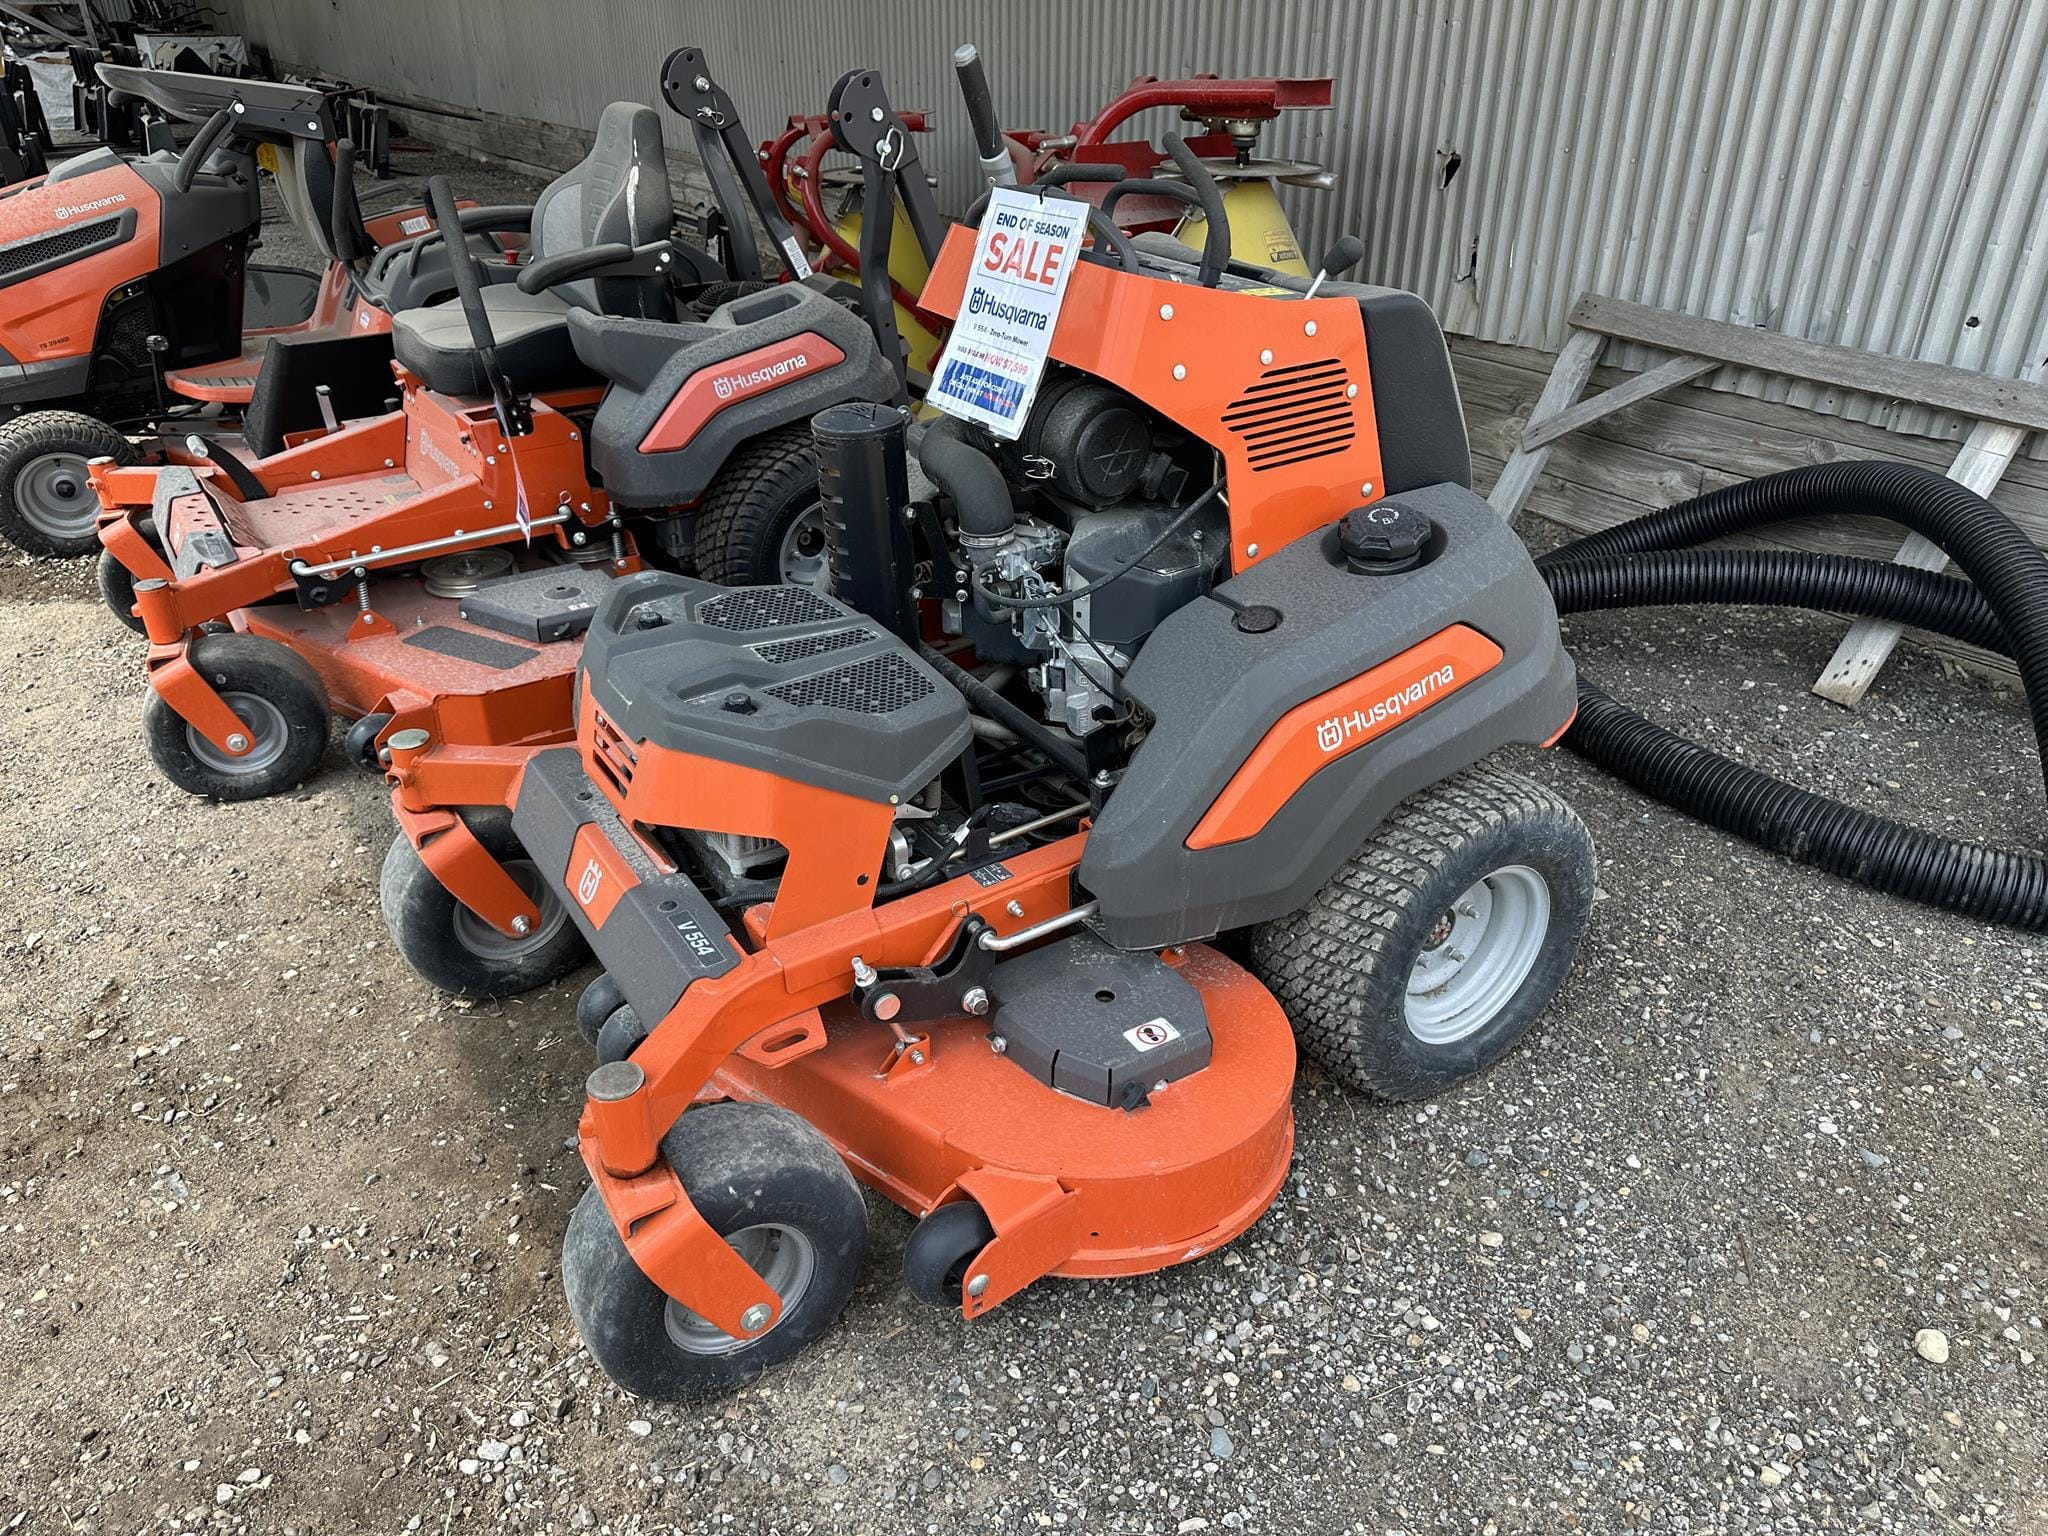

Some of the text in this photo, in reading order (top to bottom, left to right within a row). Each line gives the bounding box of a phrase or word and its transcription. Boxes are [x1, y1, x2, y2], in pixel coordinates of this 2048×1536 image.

[67, 193, 127, 216] Husqvarna
[996, 212, 1070, 239] END OF SEASON
[984, 232, 1064, 286] SALE
[982, 293, 1048, 331] Husqvarna
[990, 328, 1012, 341] Zero-Turn
[1012, 335, 1029, 346] Mower
[730, 354, 808, 391] Husqvarna
[984, 352, 1004, 367] NOW
[1002, 358, 1028, 376] $7,599
[428, 437, 460, 480] Husqvarna
[1342, 664, 1454, 737] Husqvarna
[677, 920, 716, 956] V 554
